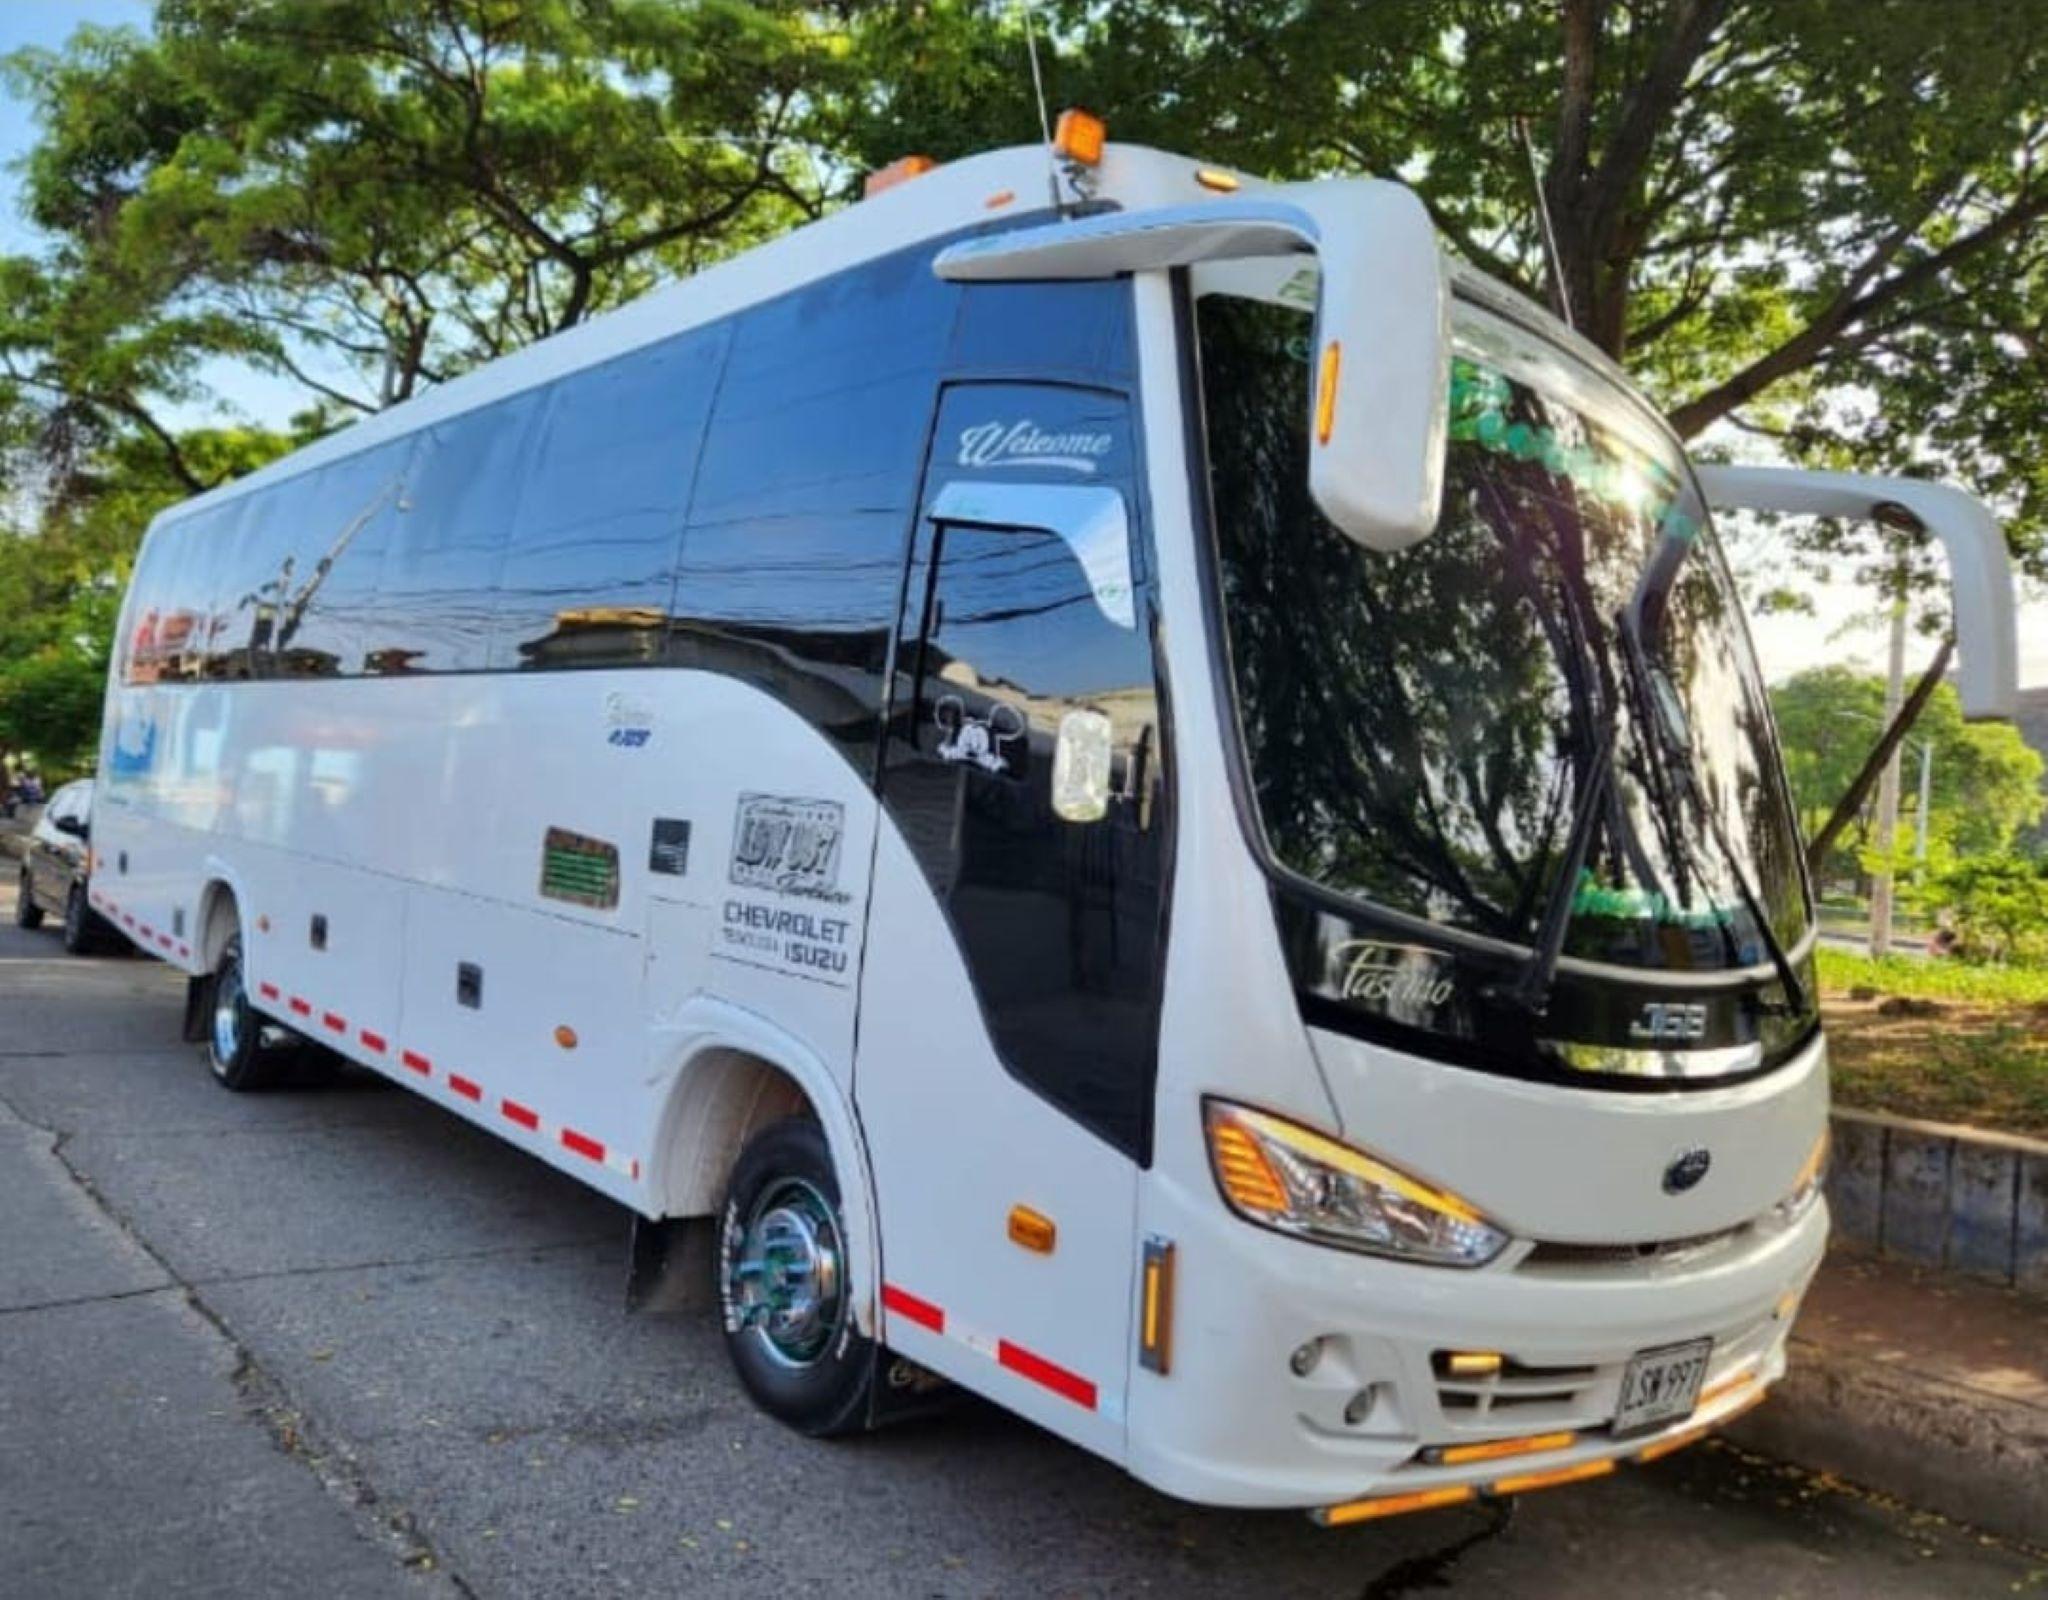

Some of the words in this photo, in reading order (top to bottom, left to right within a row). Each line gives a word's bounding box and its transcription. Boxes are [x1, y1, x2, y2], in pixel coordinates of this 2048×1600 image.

[957, 419, 1112, 467] Welcome
[723, 898, 851, 944] CHEVROLET
[784, 941, 847, 973] ISUZU
